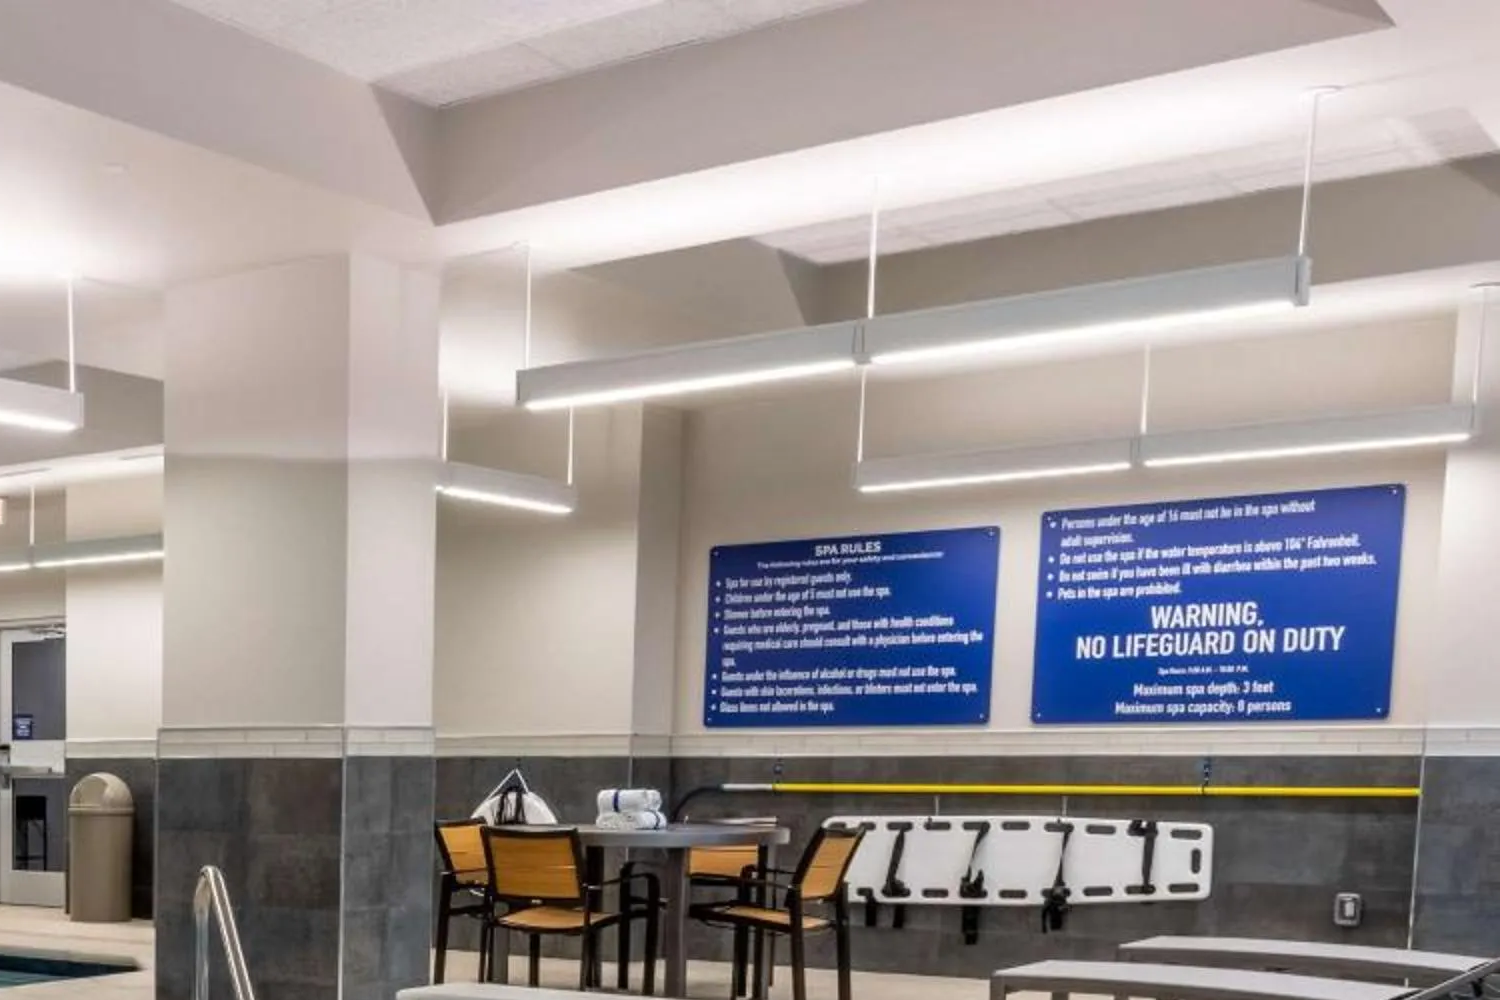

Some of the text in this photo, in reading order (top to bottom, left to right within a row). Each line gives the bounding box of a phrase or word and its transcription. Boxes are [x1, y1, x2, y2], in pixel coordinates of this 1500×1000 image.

[1123, 512, 1137, 525] the
[1139, 514, 1154, 527] age
[1244, 503, 1259, 516] the
[1261, 505, 1278, 518] spa
[1279, 498, 1316, 514] without
[815, 541, 881, 556] SPA RULES
[1103, 548, 1118, 561] the
[1119, 551, 1135, 562] spa
[1144, 546, 1159, 558] the
[1159, 544, 1184, 558] water
[1186, 541, 1242, 558] temperature
[1253, 538, 1282, 552] above
[1118, 568, 1134, 580] you
[1135, 564, 1156, 577] have
[1157, 563, 1180, 576] been
[1253, 557, 1282, 571] within
[1282, 556, 1298, 569] the
[1300, 555, 1321, 571] past
[1322, 554, 1341, 567] two
[862, 586, 874, 597] the
[1057, 586, 1076, 599] Pets
[1087, 585, 1100, 597] the
[1102, 587, 1118, 599] spa
[803, 605, 814, 615] the
[1076, 627, 1345, 658] NO LIFEGUARD ON DUTY
[1133, 682, 1182, 694] Maximum
[1185, 685, 1204, 697] spa
[1242, 680, 1249, 693] 3
[1251, 680, 1274, 692] feet
[1115, 701, 1164, 712] Maximum
[1165, 703, 1184, 715] spa
[1247, 702, 1291, 714] persons
